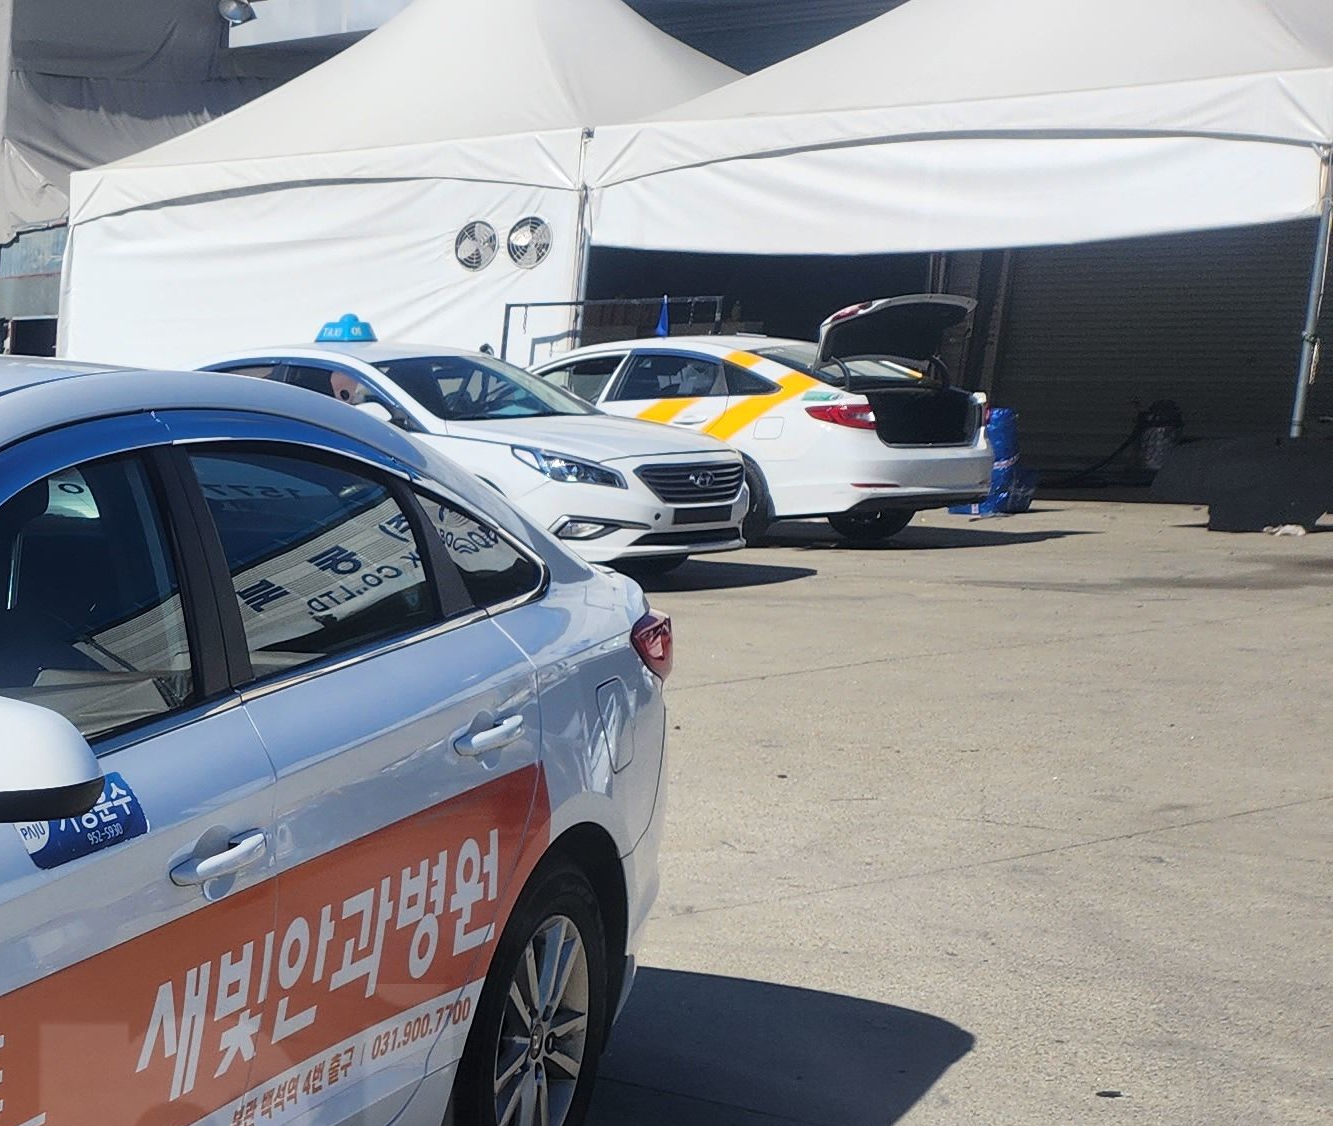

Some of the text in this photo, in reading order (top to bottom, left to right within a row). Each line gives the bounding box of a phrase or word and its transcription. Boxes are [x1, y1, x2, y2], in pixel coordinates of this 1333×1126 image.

[20, 821, 46, 841] PAJU
[86, 822, 124, 846] 952-5930
[135, 828, 499, 1102] 새빛안과병원
[302, 1059, 327, 1096] 4번
[328, 1045, 356, 1086] 출구
[371, 996, 472, 1060] 031.900.7700
